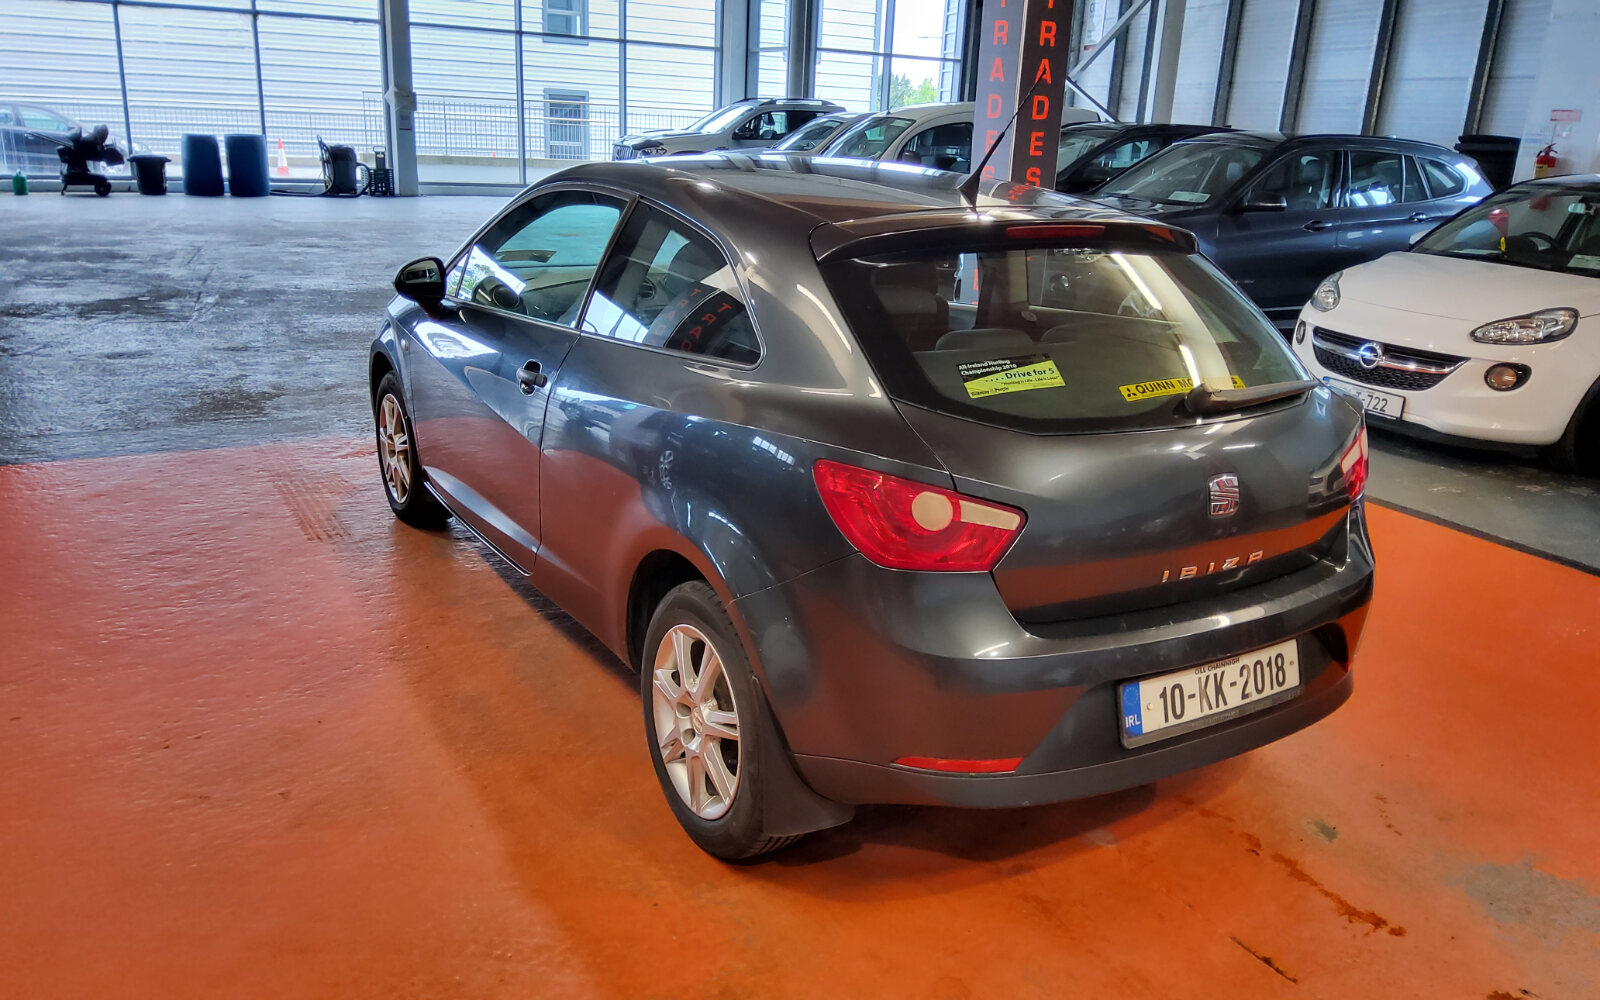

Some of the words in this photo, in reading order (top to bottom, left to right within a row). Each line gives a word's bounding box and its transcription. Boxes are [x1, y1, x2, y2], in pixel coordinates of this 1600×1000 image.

[959, 361, 988, 370] All-Ireland
[961, 366, 1002, 376] Championship
[1005, 370, 1032, 380] Drive
[1033, 368, 1047, 376] for
[1049, 367, 1055, 375] 5
[1135, 380, 1176, 395] QUINN
[1161, 550, 1264, 583] IBIZA
[1159, 652, 1287, 724] 10-KK-2018
[1125, 714, 1142, 729] IRL
